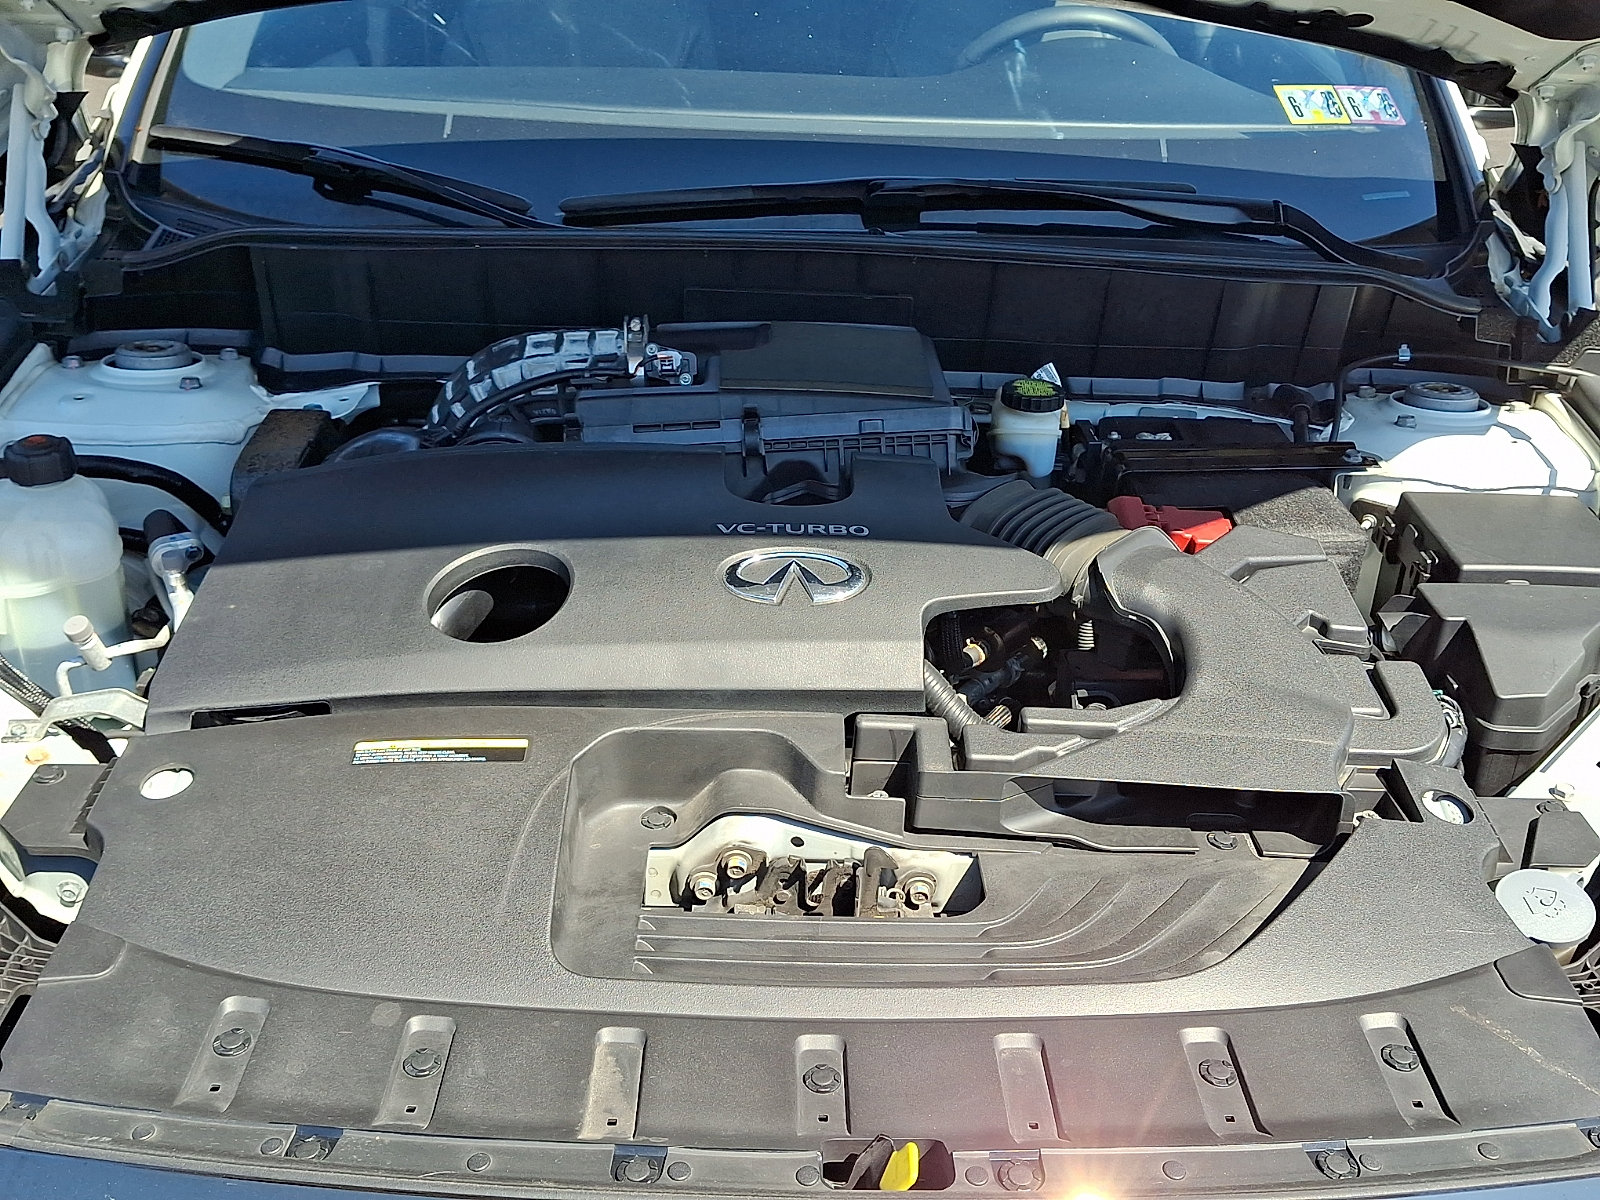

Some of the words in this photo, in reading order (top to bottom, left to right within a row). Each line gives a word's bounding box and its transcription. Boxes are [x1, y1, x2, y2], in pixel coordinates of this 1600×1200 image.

[1287, 96, 1304, 117] 6
[1347, 96, 1363, 118] 6
[715, 523, 870, 536] VC-TURBO
